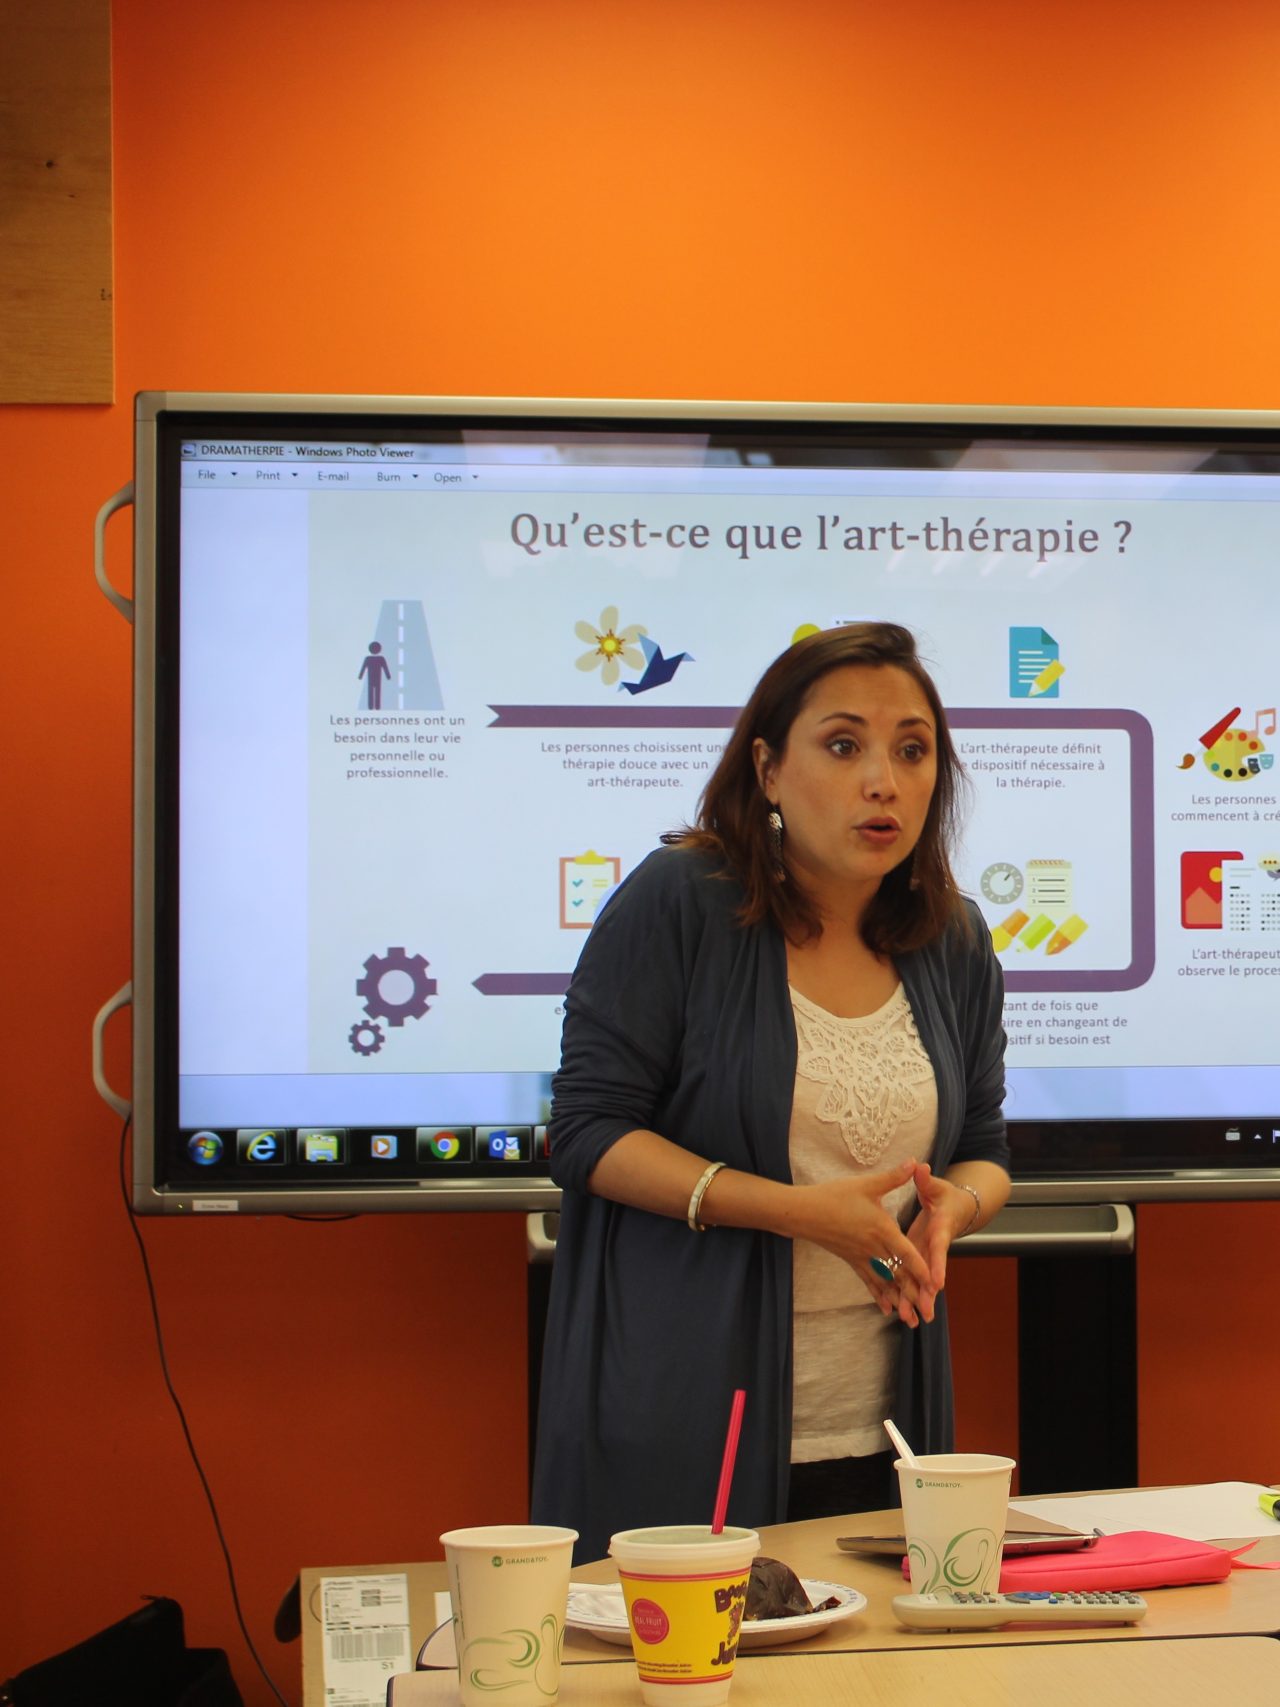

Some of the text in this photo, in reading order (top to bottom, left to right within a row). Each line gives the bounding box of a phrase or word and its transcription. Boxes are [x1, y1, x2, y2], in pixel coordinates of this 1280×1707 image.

[201, 445, 284, 456] DRAMATHERPIE
[295, 446, 343, 457] Windows
[347, 447, 376, 458] Photo
[379, 448, 414, 458] Viewer
[198, 470, 216, 480] File
[256, 470, 280, 481] Print
[318, 471, 350, 481] E-mail
[377, 472, 400, 482] Burn
[434, 472, 462, 485] Open
[510, 512, 1133, 562] Qu'est-ce que l'art-thérapie ?
[330, 714, 465, 727] Les personnes ont un
[334, 732, 462, 743] besoin dans leur vie
[540, 741, 562, 753] Les
[565, 743, 630, 755] personnes
[633, 741, 703, 753] choisissent
[960, 742, 1102, 756] L'art-thérapeute définit
[350, 750, 445, 762] personnelle ou
[562, 758, 709, 771] thérapie douce avec un
[971, 759, 1027, 772] dispositif
[1030, 759, 1094, 771] nécessaire
[1098, 760, 1105, 771] à
[346, 767, 449, 779] professionnelle.
[587, 776, 684, 789] art-thérapeute.
[996, 776, 1066, 789] la thérapie.
[1191, 794, 1277, 807] Les personnes
[1171, 811, 1249, 821] commencent
[1253, 810, 1260, 821] à
[1177, 965, 1226, 976] observe
[1229, 965, 1240, 976] le
[1003, 1000, 1098, 1013] tant de fois que
[1001, 1017, 1128, 1029] aire en changeant de
[1008, 1034, 1111, 1046] sitif si besoin est
